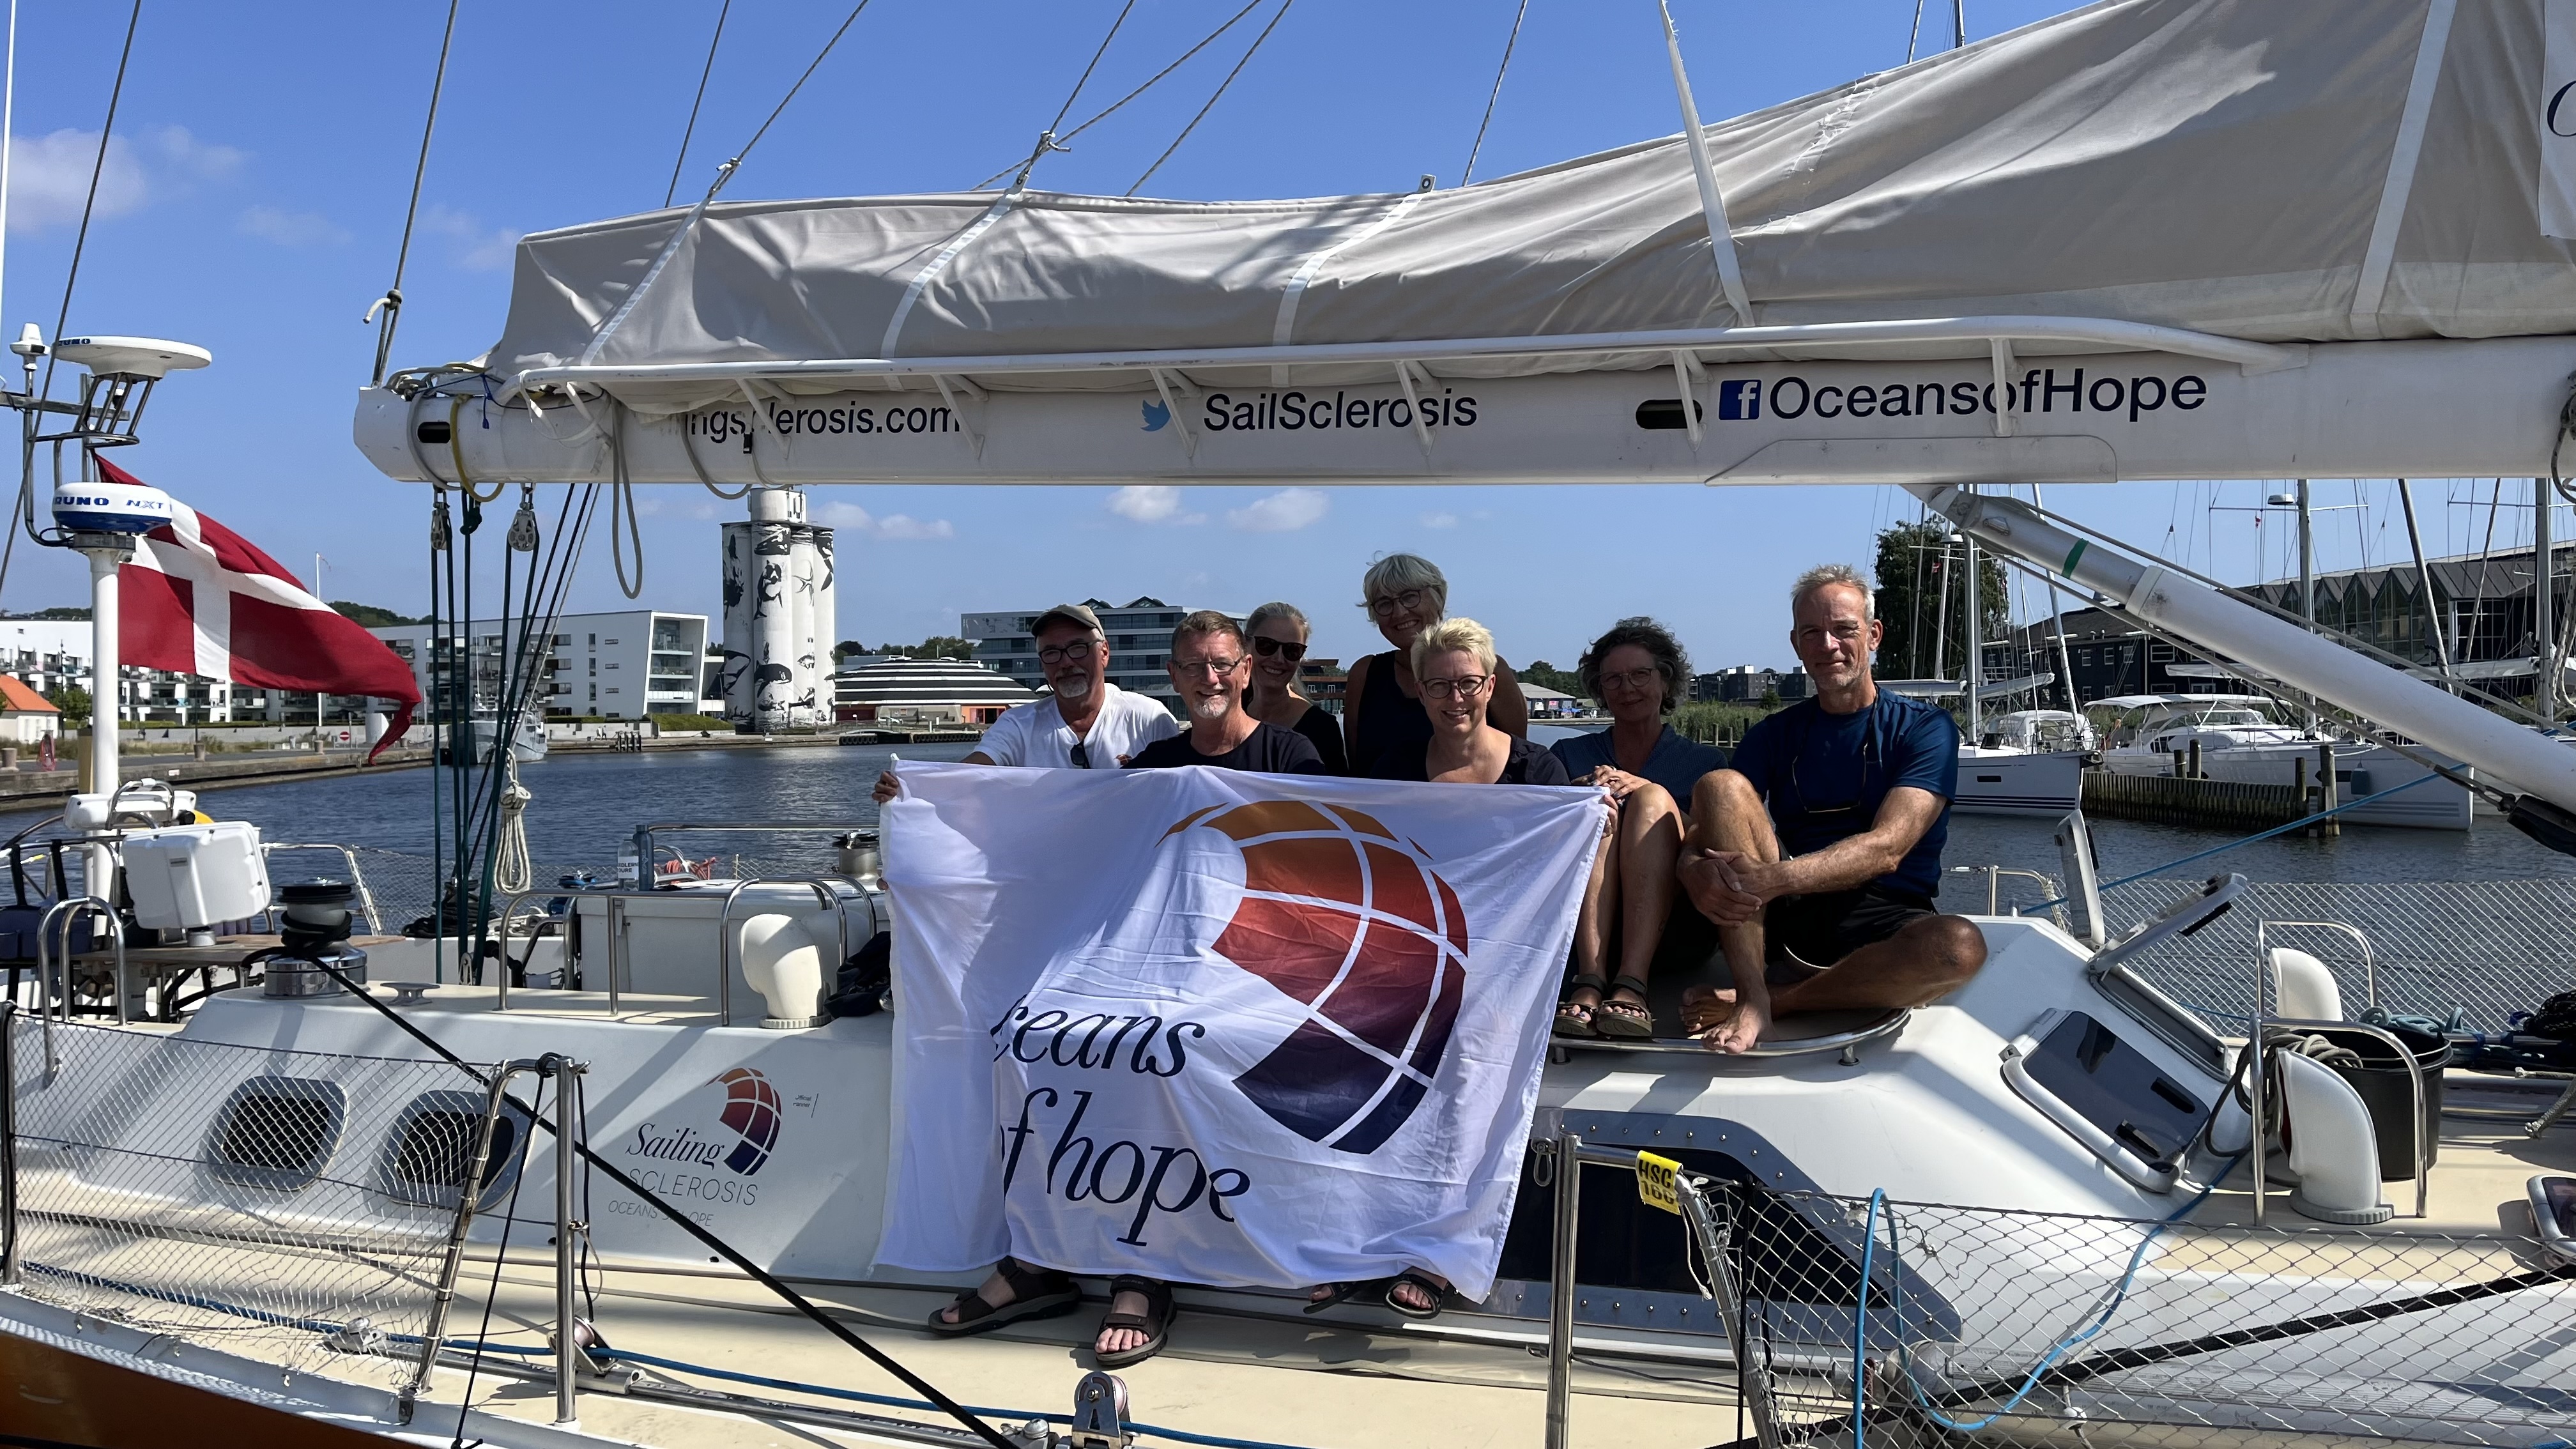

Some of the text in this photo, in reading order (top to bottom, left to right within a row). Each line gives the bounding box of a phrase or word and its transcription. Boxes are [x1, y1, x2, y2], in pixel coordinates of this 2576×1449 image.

[1204, 388, 1477, 431] SailSclerosis
[1770, 367, 2207, 422] OceansofHope
[126, 500, 164, 509] NXT
[625, 1123, 724, 1170] Sailing
[1000, 1087, 1250, 1246] f hope
[630, 1169, 758, 1206] SCLEROSIS
[1639, 1159, 1672, 1189] HSC
[608, 1200, 658, 1219] OCEANS
[681, 1211, 714, 1227] OPE
